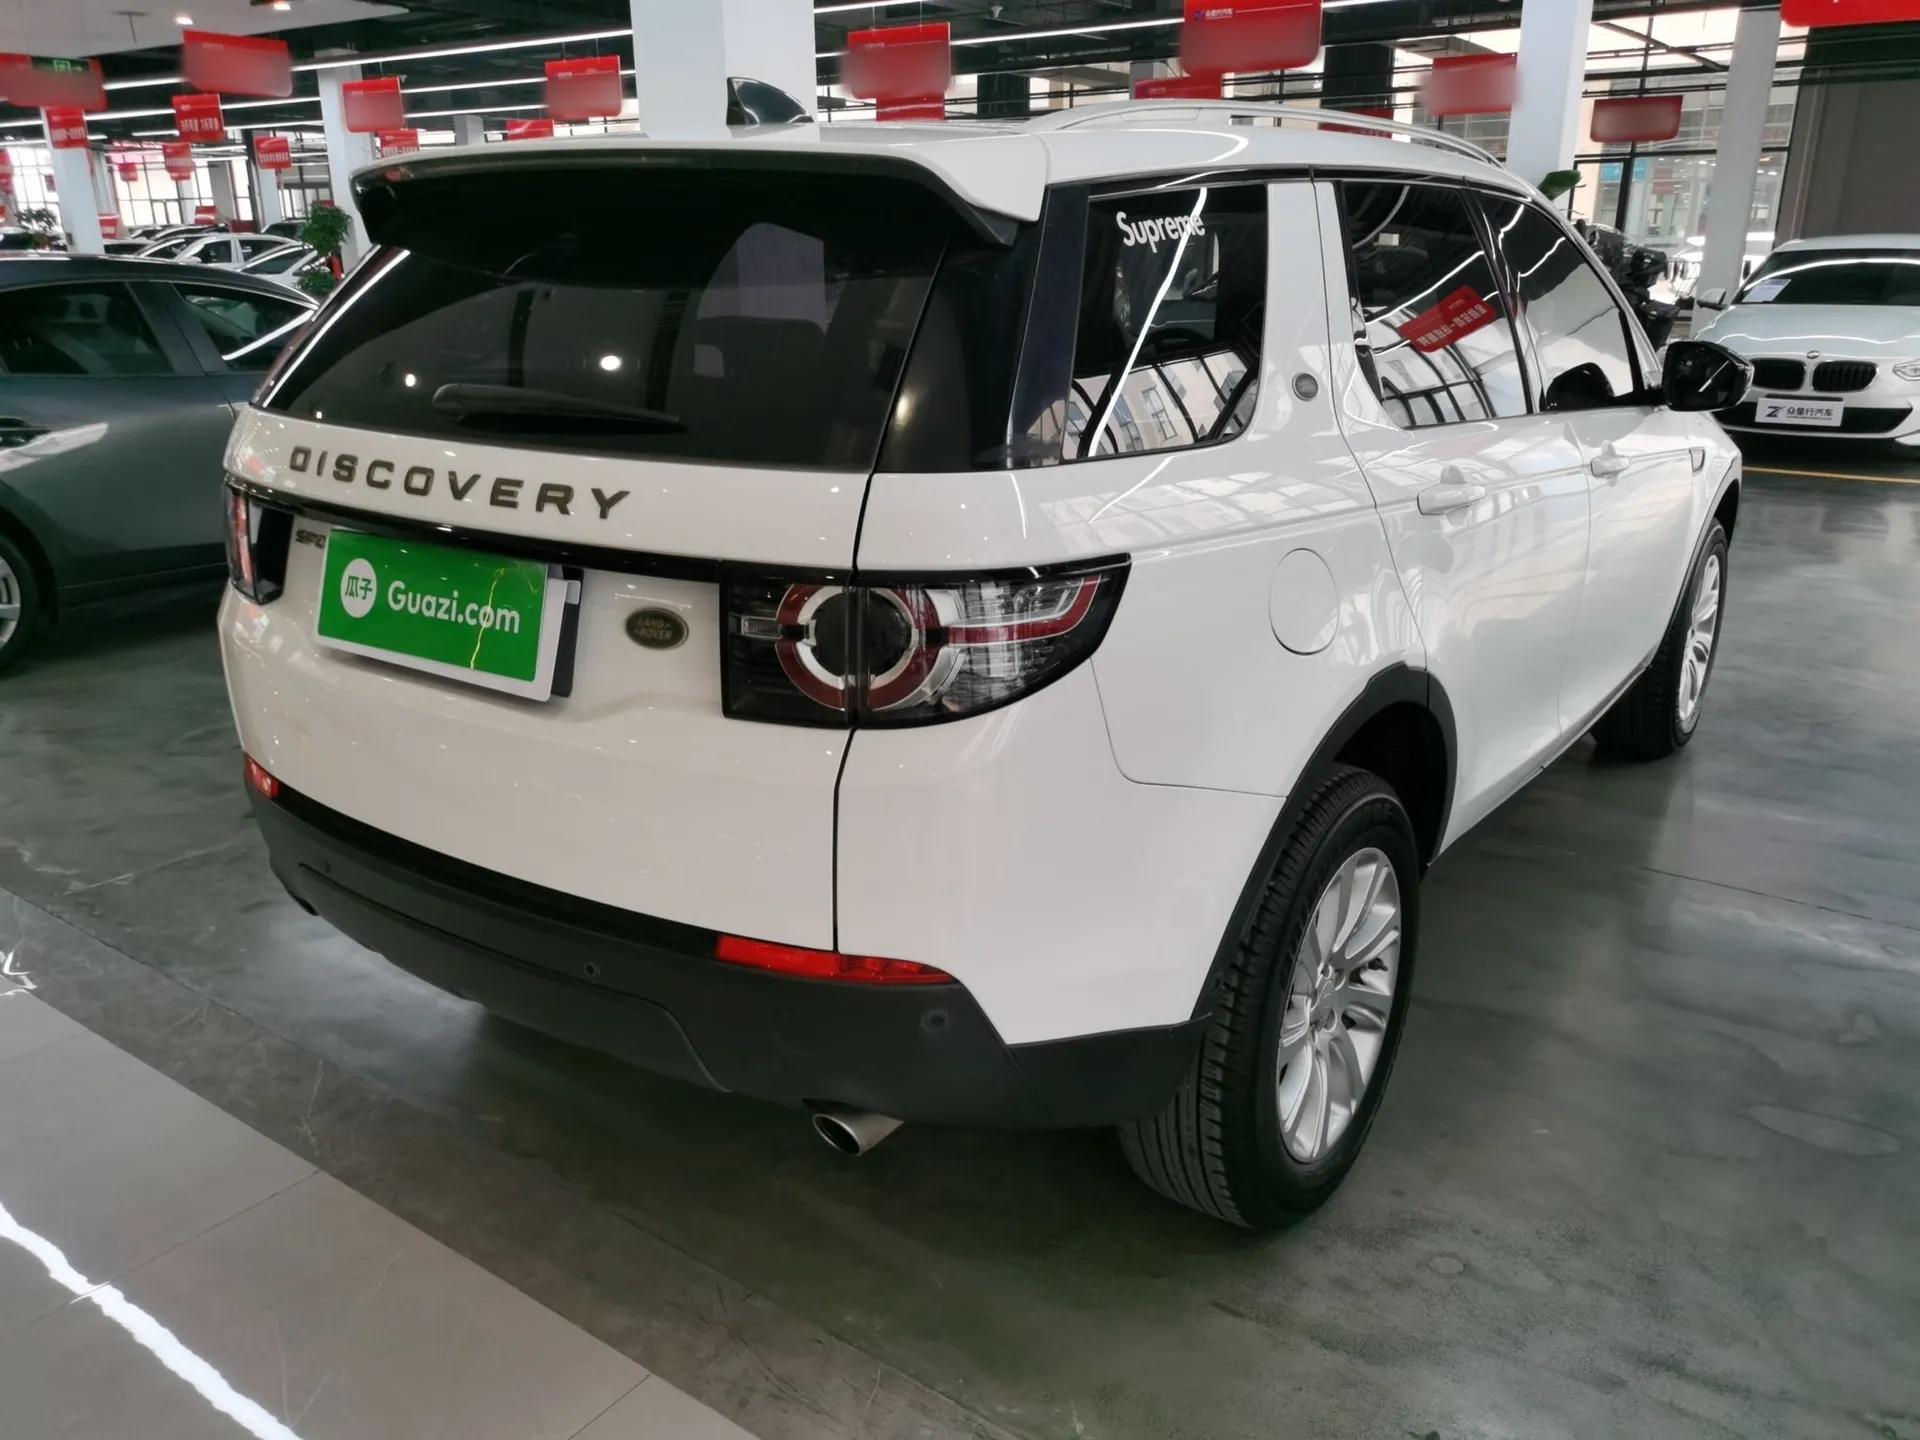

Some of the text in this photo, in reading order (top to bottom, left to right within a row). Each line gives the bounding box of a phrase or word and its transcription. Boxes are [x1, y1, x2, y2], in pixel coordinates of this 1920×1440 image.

[1116, 211, 1206, 253] Supreme
[289, 445, 631, 520] DISCOVERY
[295, 529, 326, 549] SPO
[344, 575, 373, 601] 瓜子
[387, 580, 520, 634] Guazi.com
